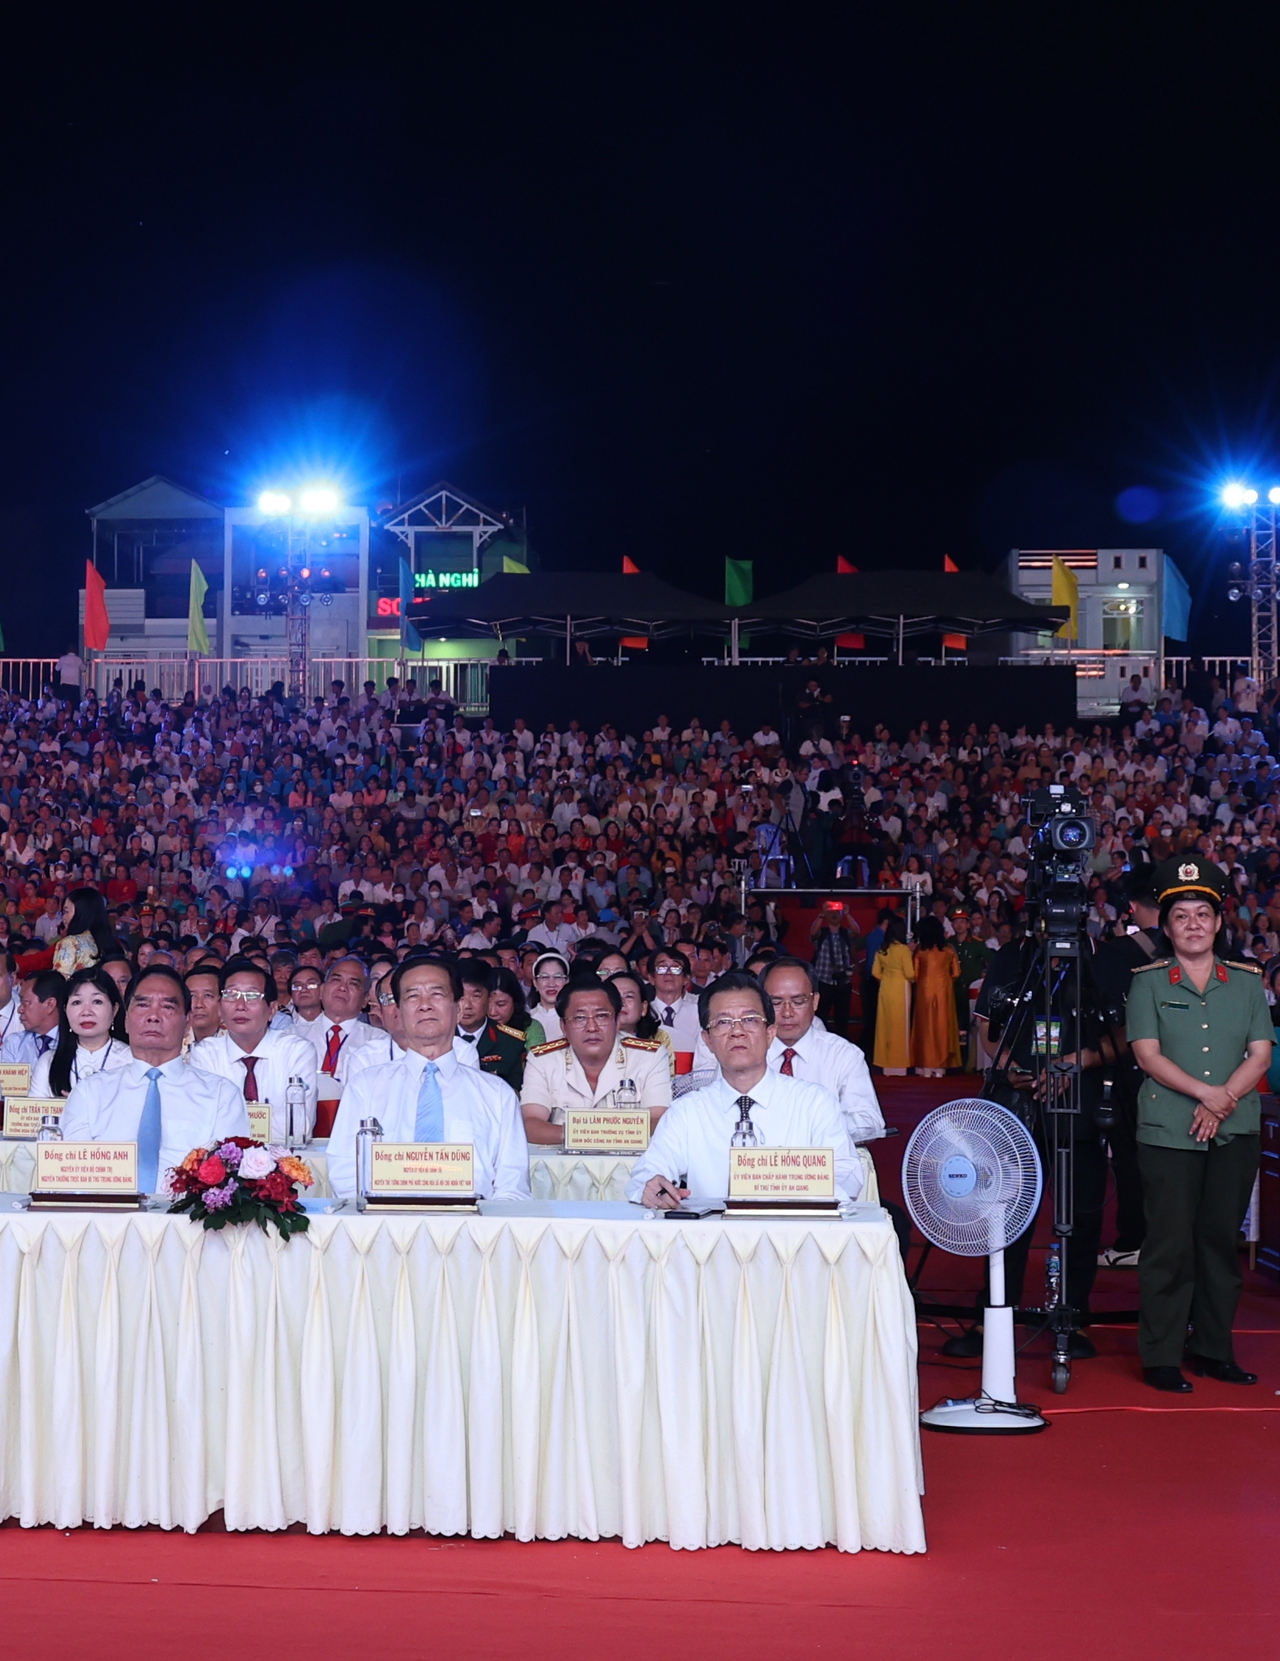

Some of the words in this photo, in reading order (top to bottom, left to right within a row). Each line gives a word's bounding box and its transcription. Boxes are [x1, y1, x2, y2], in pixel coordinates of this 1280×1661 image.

[438, 568, 479, 588] NGHỈ
[45, 1149, 63, 1162] Đồng
[78, 1148, 87, 1160] LÊ
[113, 1151, 128, 1160] ANH
[375, 1150, 392, 1162] Đồng
[406, 1147, 433, 1160] NGUYỄN
[435, 1148, 449, 1160] TẤN
[451, 1149, 470, 1160] DŨNG
[737, 1153, 755, 1168] Đồng
[769, 1152, 778, 1166] LÊ
[803, 1155, 826, 1168] QUANG
